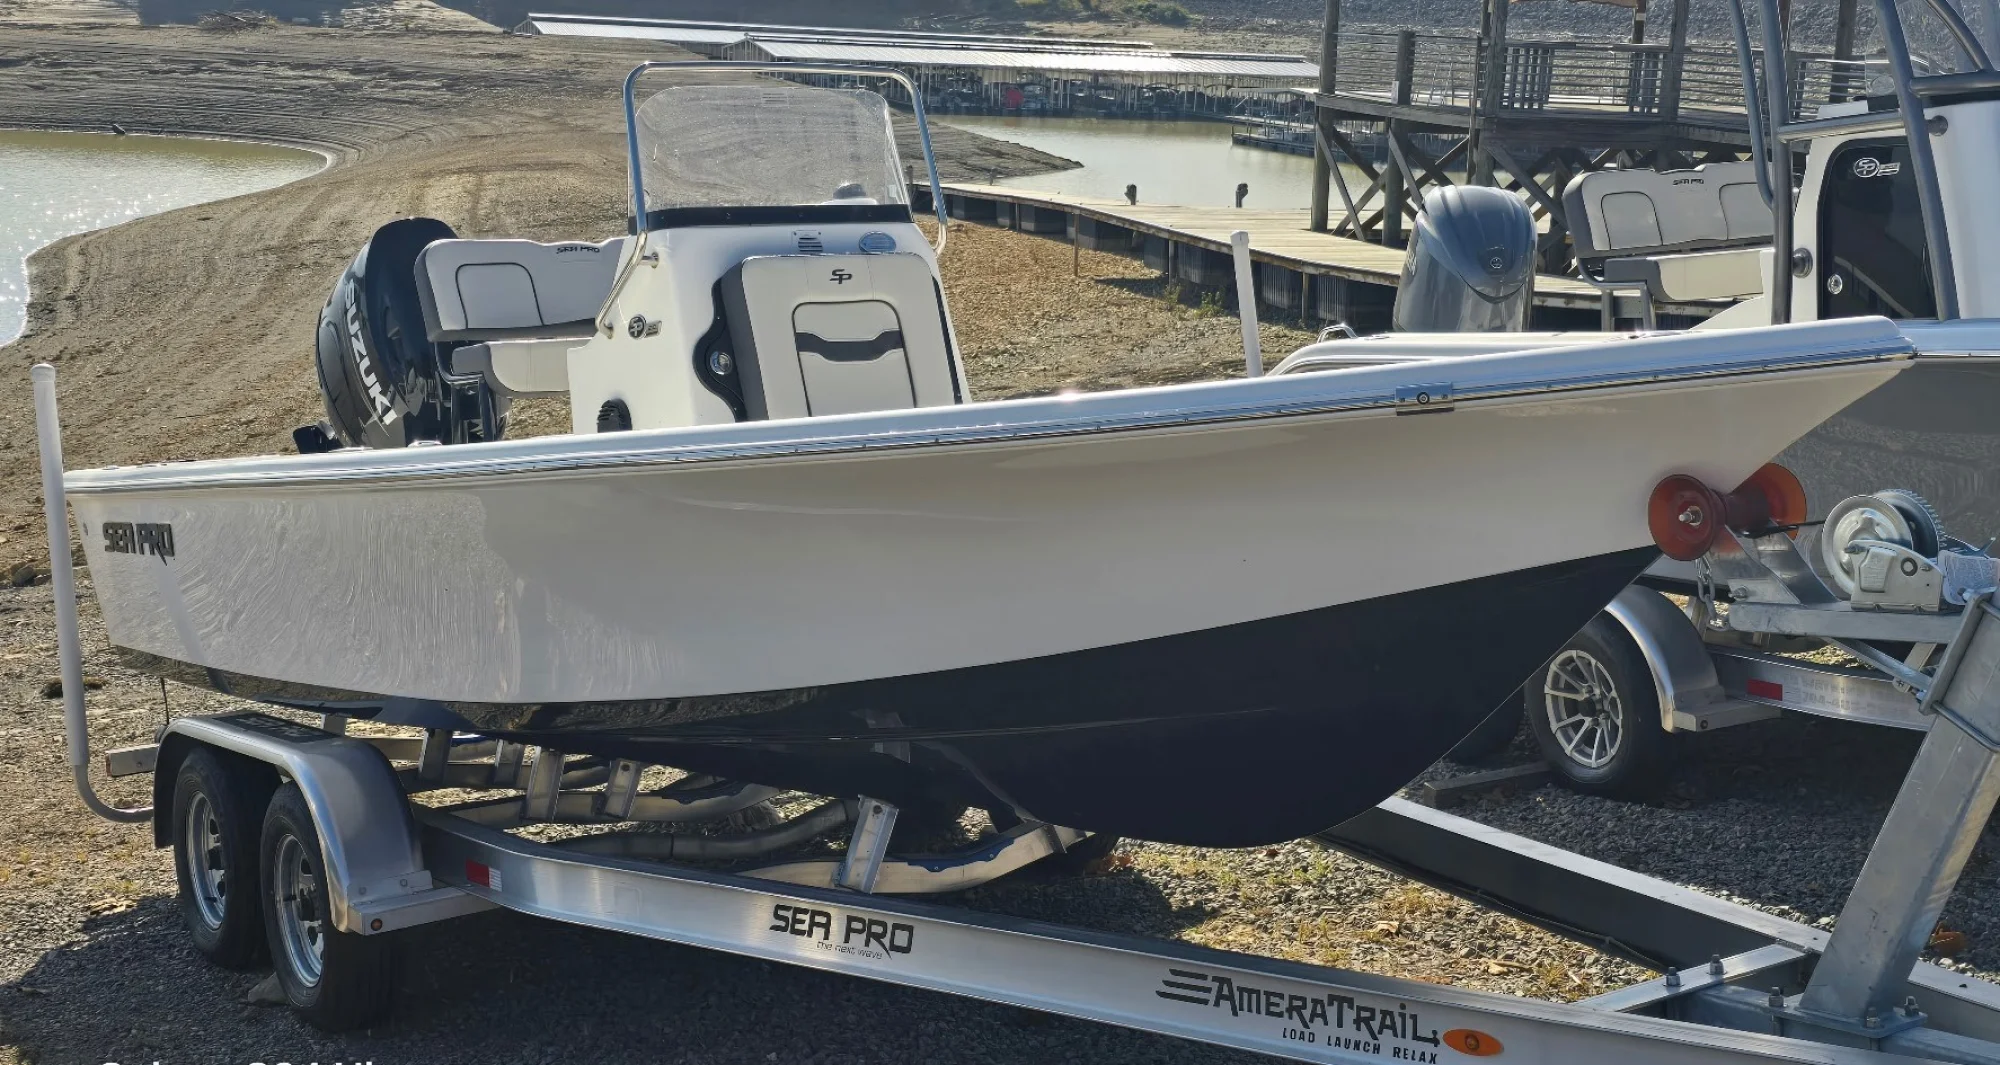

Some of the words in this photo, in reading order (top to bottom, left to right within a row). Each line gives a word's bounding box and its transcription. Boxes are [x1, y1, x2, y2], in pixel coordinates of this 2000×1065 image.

[345, 277, 398, 426] SUZUKI
[102, 521, 136, 554] SEA
[135, 522, 175, 567] PRO
[769, 903, 832, 941] SEA
[843, 914, 914, 960] PRO
[816, 940, 833, 951] the
[834, 944, 857, 955] next
[857, 949, 883, 960] wave
[1282, 1027, 1316, 1043] LOAD
[1327, 1034, 1381, 1055] LAUNCH
[1392, 1046, 1438, 1065] RELAX
